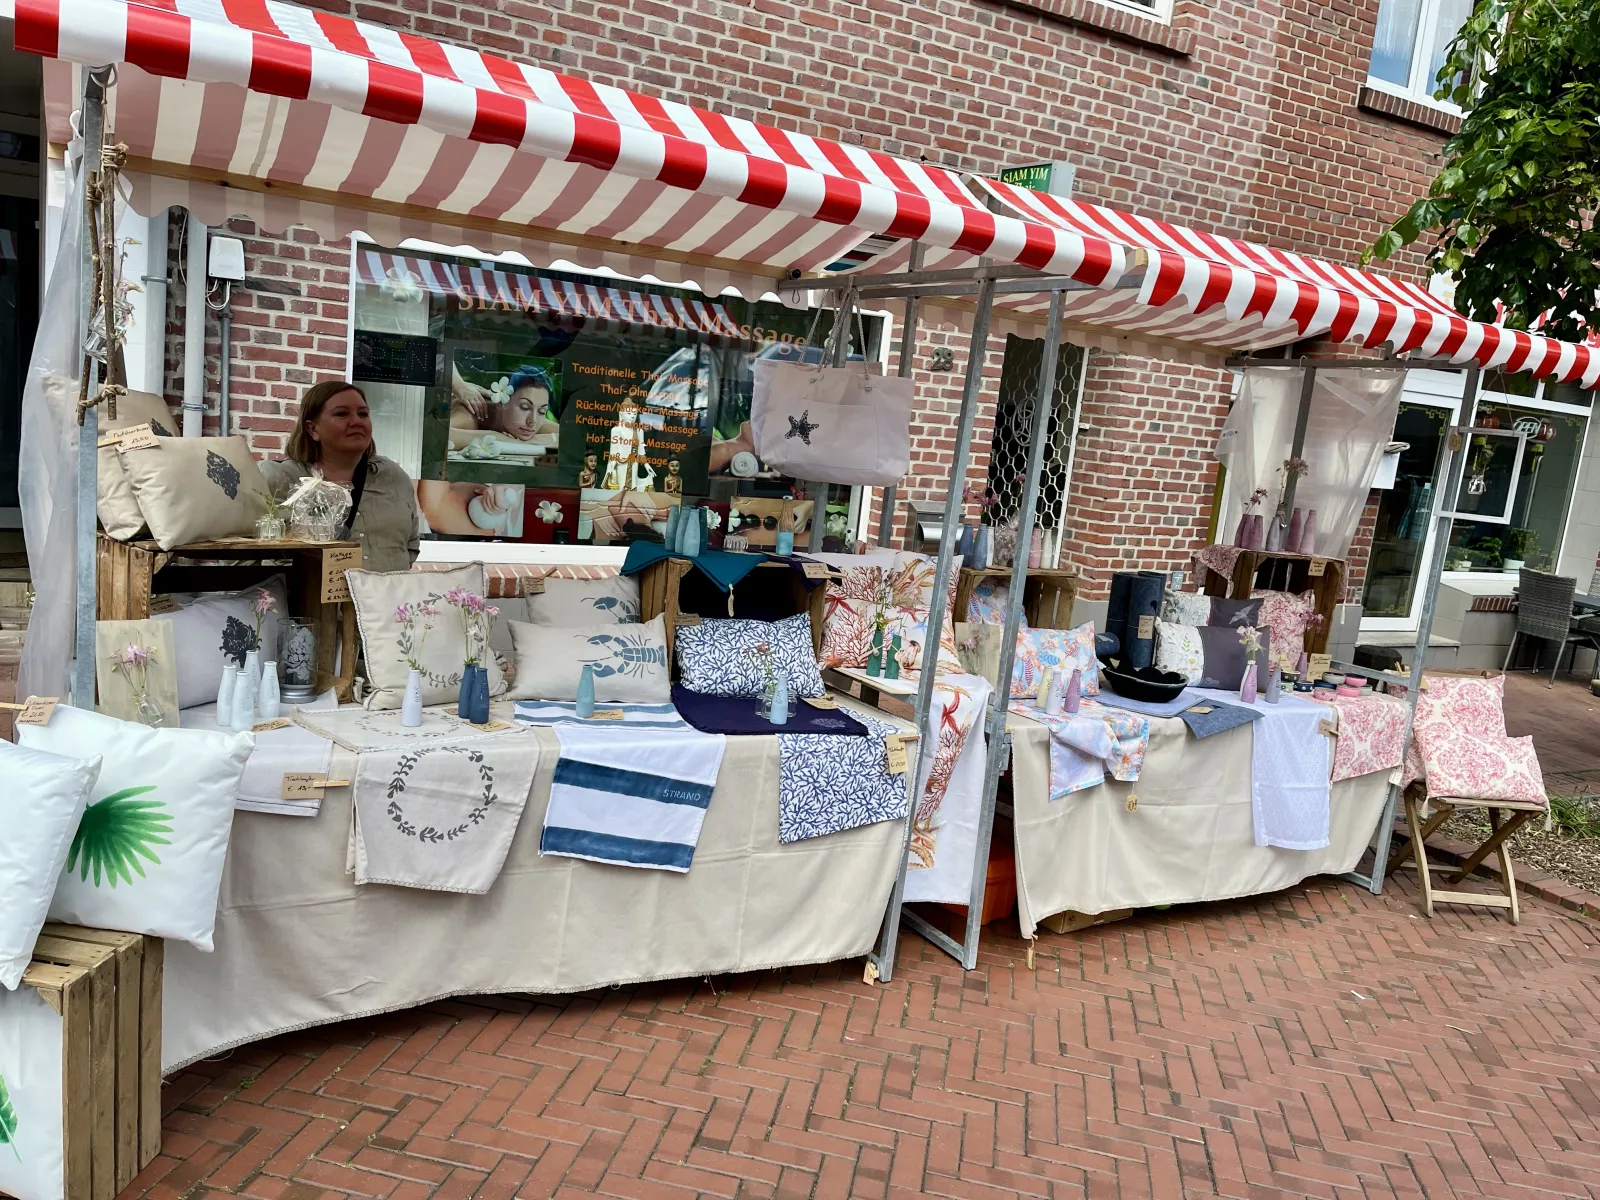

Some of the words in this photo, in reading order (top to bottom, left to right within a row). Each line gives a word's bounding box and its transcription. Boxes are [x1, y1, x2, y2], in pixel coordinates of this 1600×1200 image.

[1003, 169, 1027, 184] SIAM
[1030, 167, 1049, 180] YIM
[457, 284, 543, 314] SIAM
[551, 290, 612, 319] YIM
[572, 362, 636, 379] Traditionelle
[663, 789, 701, 801] STRAND
